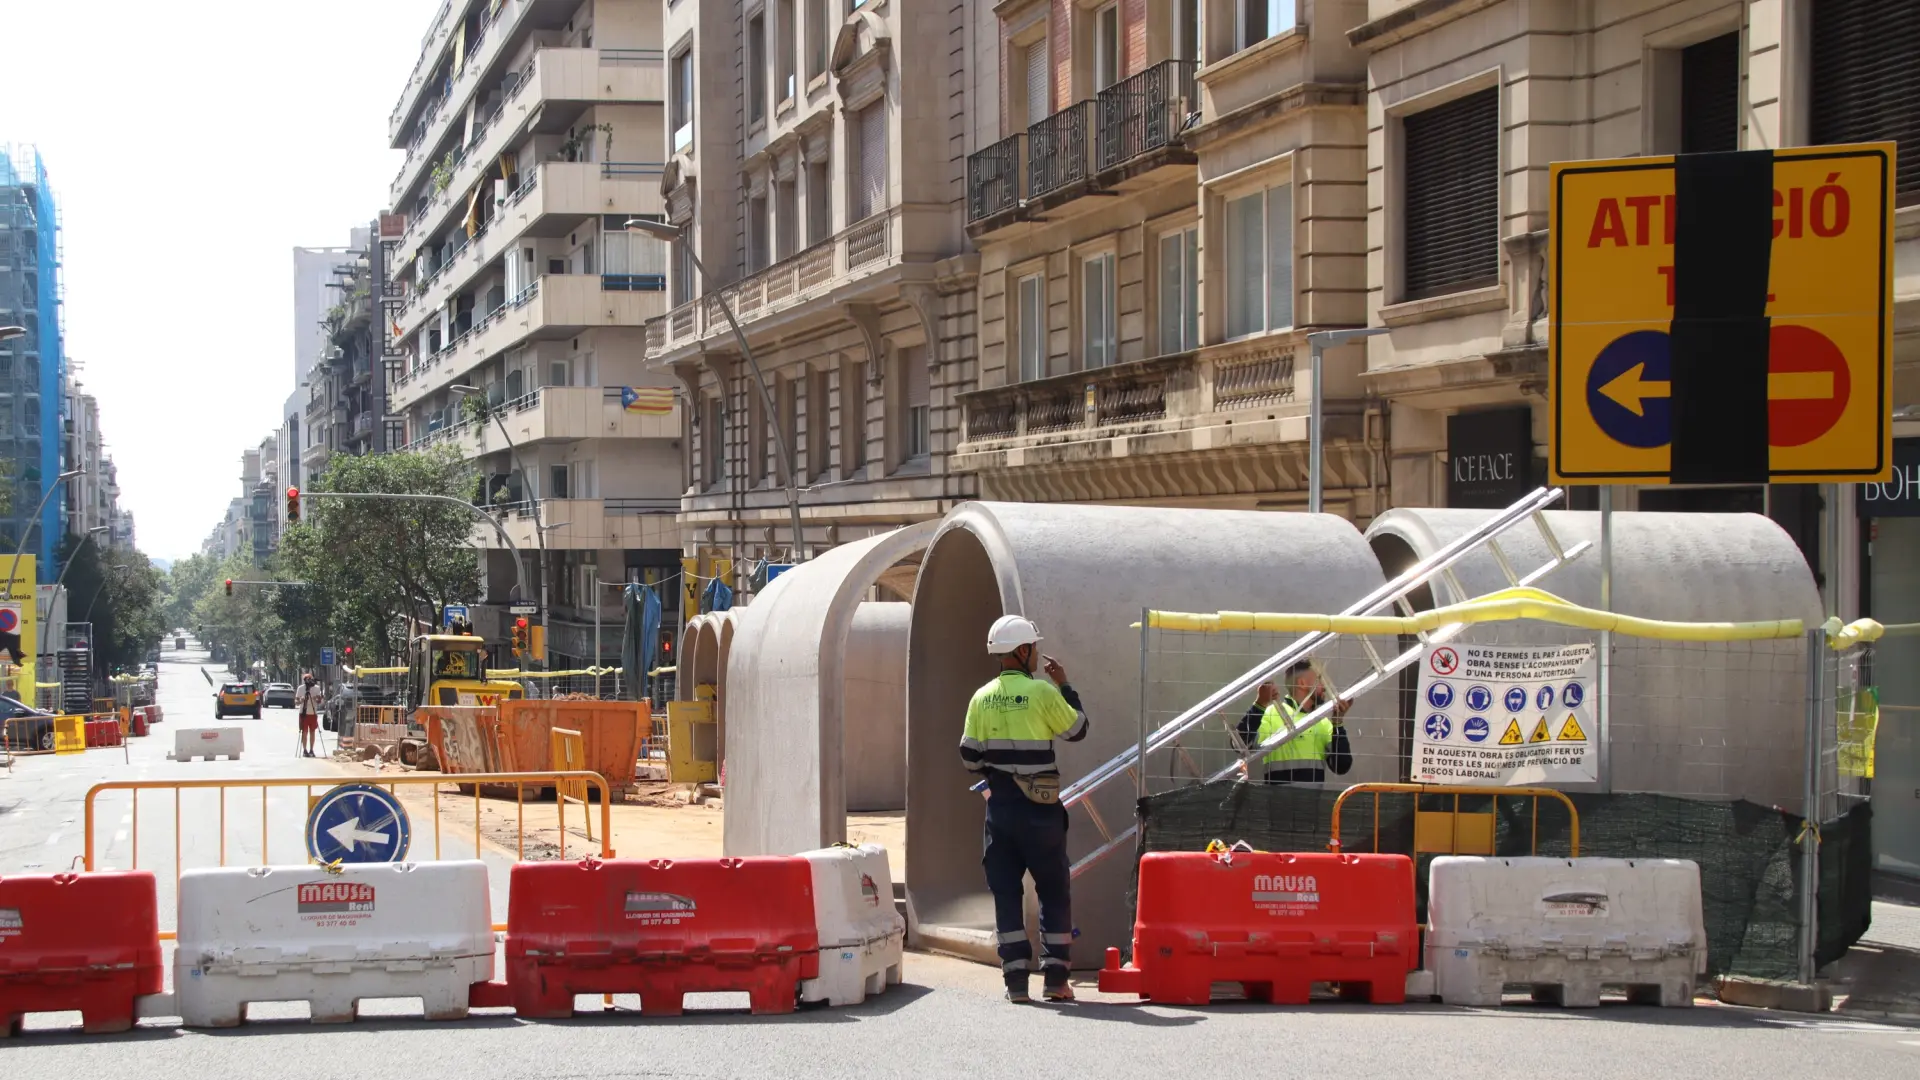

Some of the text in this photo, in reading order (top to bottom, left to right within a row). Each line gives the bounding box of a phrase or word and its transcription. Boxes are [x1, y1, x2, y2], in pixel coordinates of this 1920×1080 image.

[1467, 649, 1480, 657] NO
[1532, 651, 1541, 659] EL
[1543, 651, 1555, 659] PAS
[1562, 648, 1590, 657] AQUESTA
[1467, 659, 1491, 668] OBRA
[1493, 661, 1520, 669] SENSE
[1466, 668, 1576, 679] D'UNA PERSONA AUTORITZADA
[1423, 747, 1435, 755] EN
[1437, 748, 1477, 758] AQUESTA
[1479, 751, 1503, 760] OBRA
[1515, 748, 1553, 759] OBLIGATORI
[1554, 747, 1571, 755] FER
[1422, 757, 1434, 765] DE
[1436, 758, 1464, 767] TOTES
[1466, 760, 1482, 768] LES
[1570, 757, 1582, 765] DE
[1421, 767, 1501, 779] RISCOS LABORAL
[1254, 875, 1317, 891] MAUSA
[300, 885, 372, 902] MAUSA
[349, 902, 374, 911] Rent
